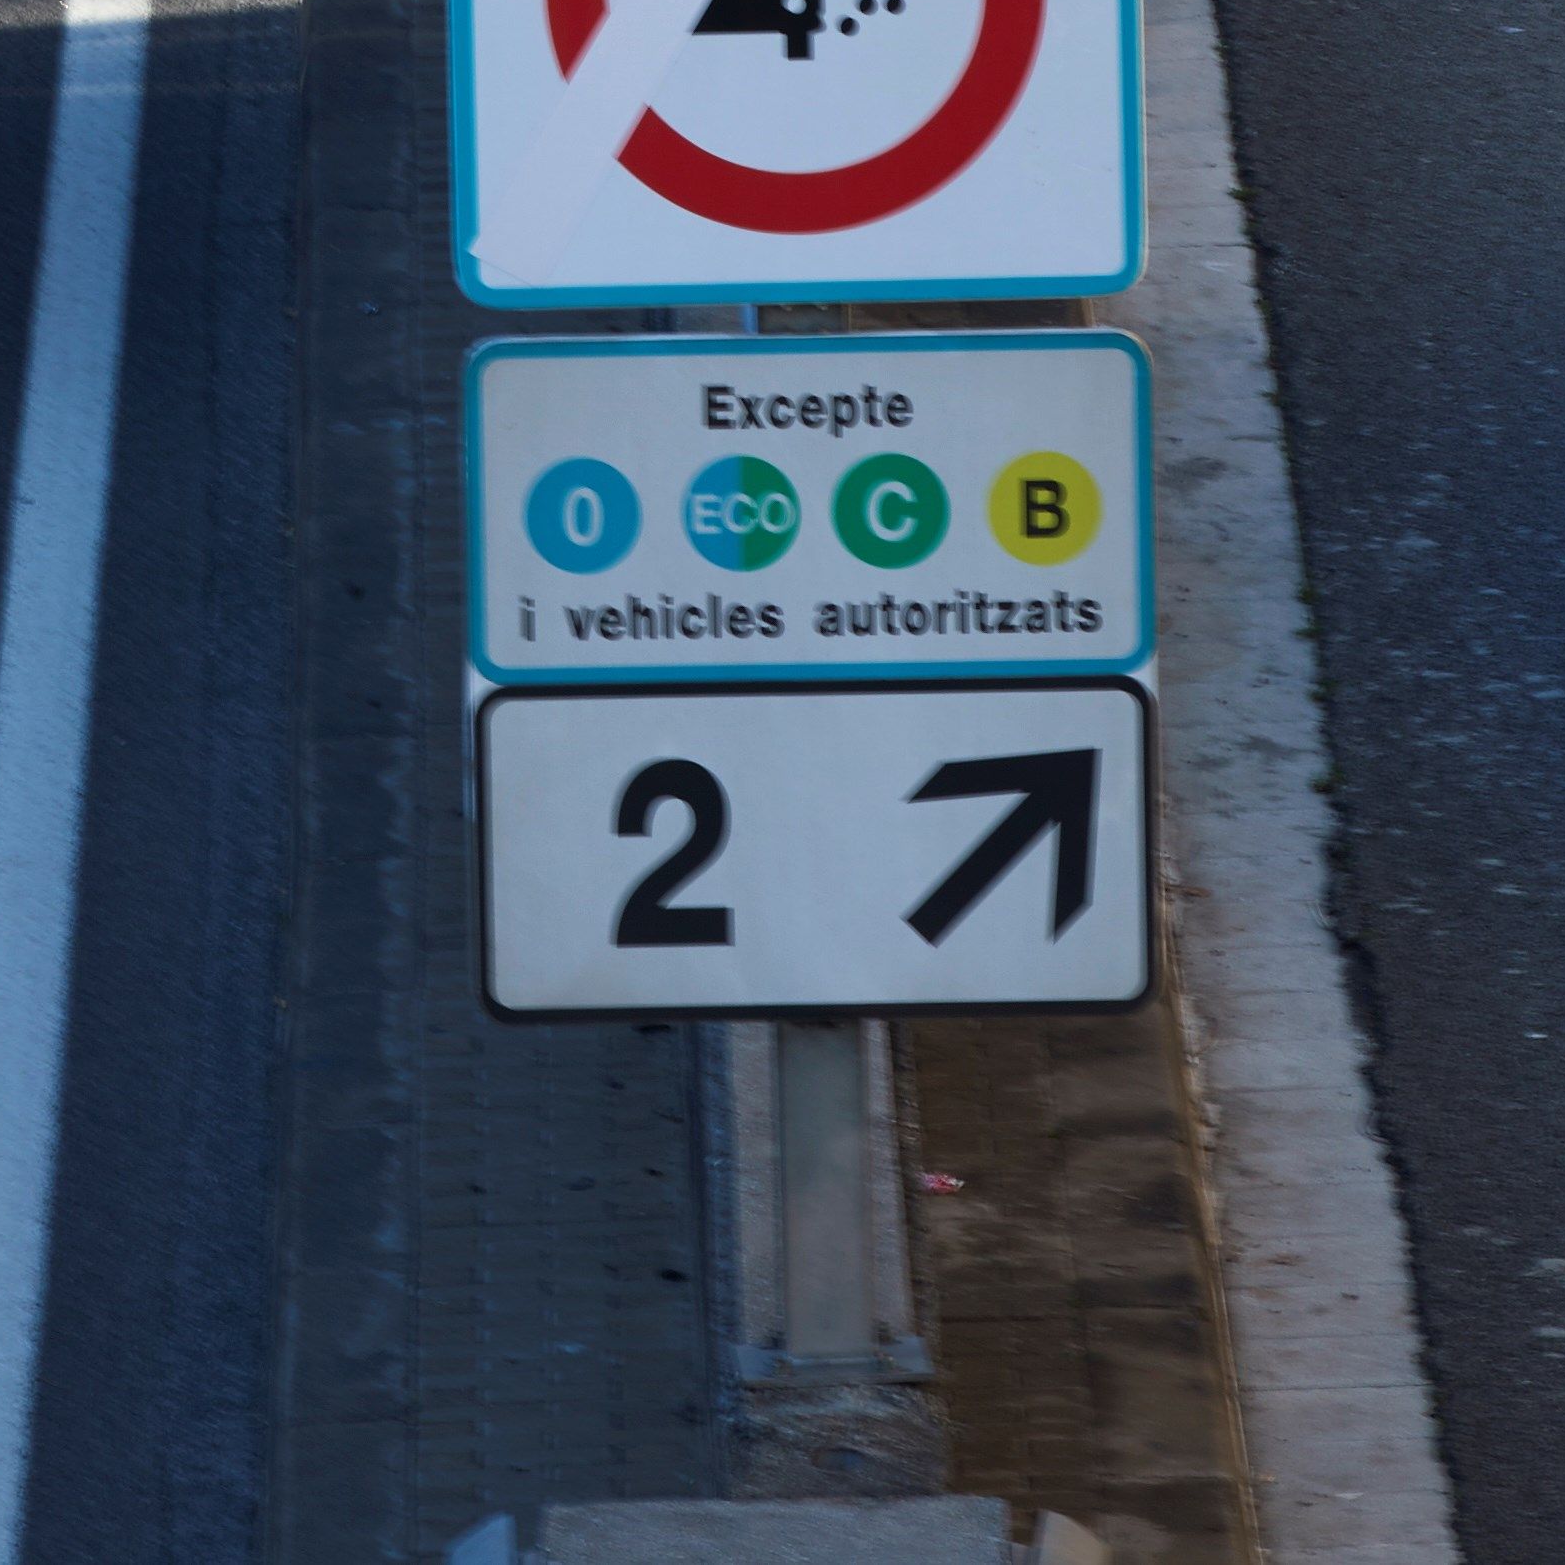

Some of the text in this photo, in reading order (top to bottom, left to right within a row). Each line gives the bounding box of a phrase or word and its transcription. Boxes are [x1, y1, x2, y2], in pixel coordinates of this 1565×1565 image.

[701, 384, 914, 438] Excepte
[691, 493, 797, 534] ECO
[868, 481, 916, 542] C
[1021, 479, 1070, 540] B
[518, 588, 1104, 642] i vehicles autoritzats
[611, 757, 735, 948] 2
